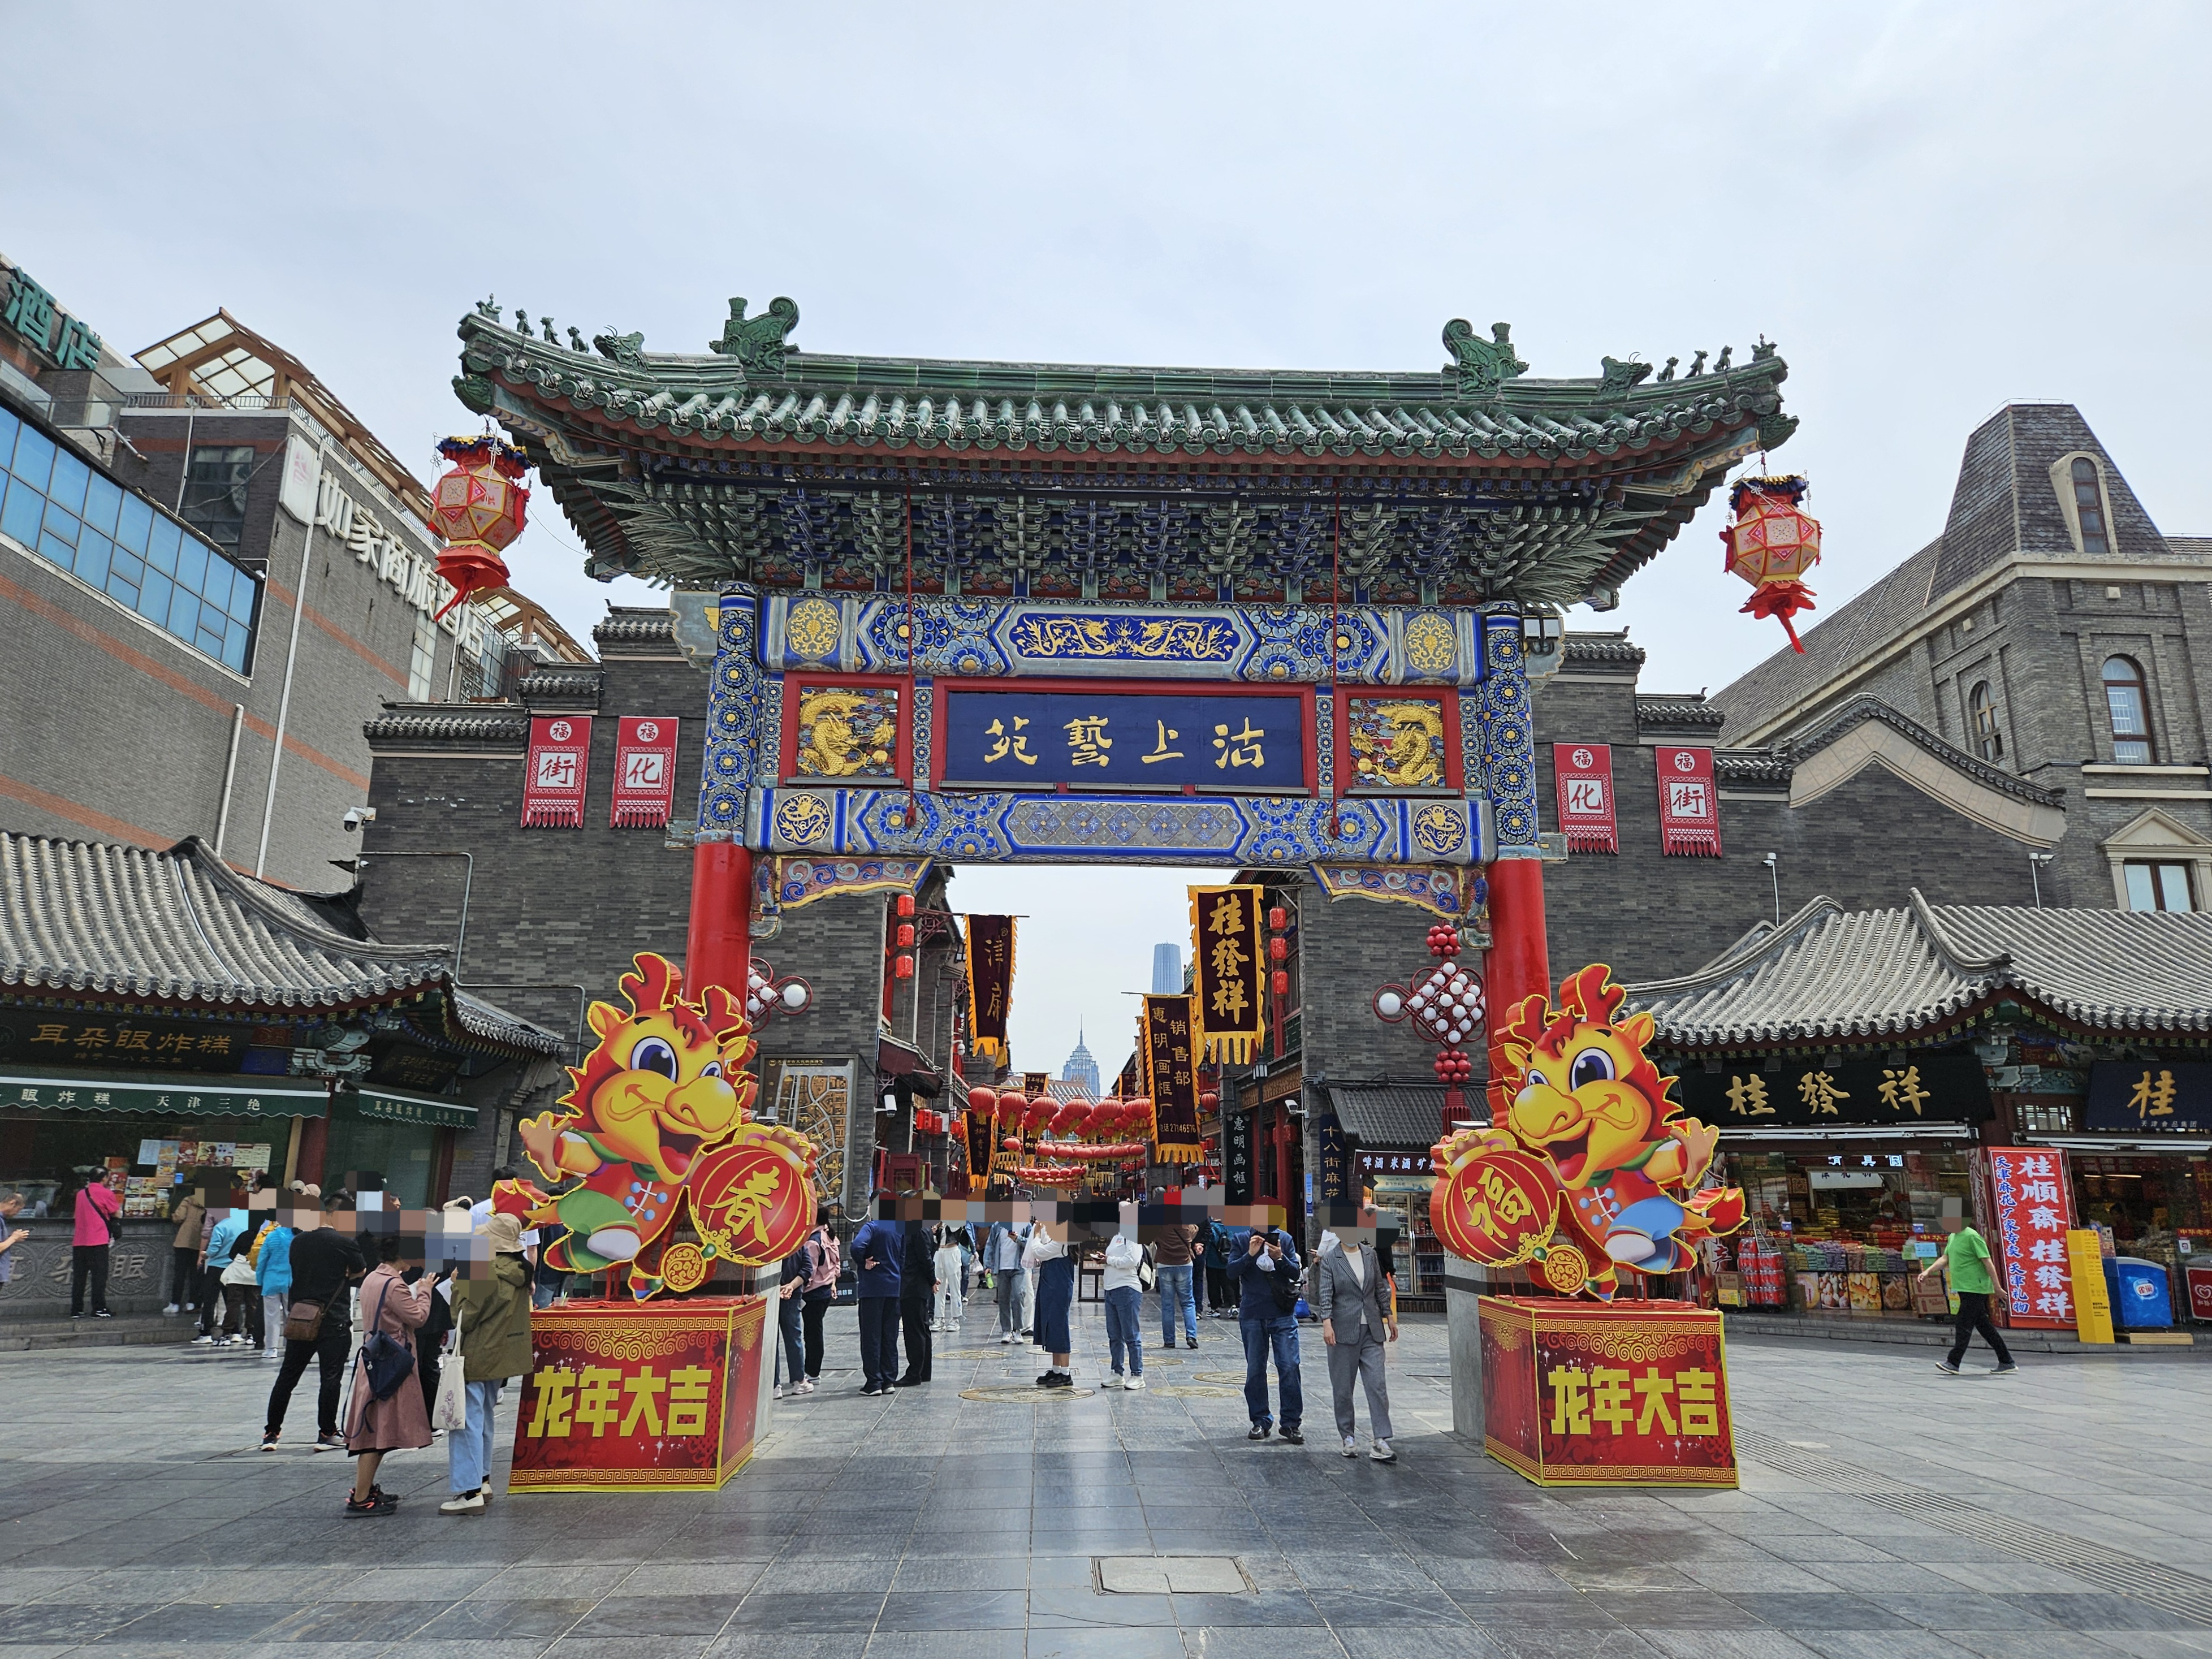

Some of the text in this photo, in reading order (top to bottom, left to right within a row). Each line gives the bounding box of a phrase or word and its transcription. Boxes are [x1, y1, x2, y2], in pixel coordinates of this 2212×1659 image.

[5, 266, 102, 370] 酒店
[314, 469, 485, 658] 如家商旅酒店
[553, 723, 569, 740] 福
[640, 723, 656, 740] 福
[539, 758, 575, 785] 街
[627, 757, 661, 785] 化
[1575, 750, 1592, 768] 福
[1677, 753, 1694, 770] 福
[1570, 783, 1602, 811] 化
[1672, 788, 1704, 814] 街
[1208, 893, 1249, 1025] 桂發祥
[30, 1024, 232, 1055] 耳朵眼炸糕
[1151, 1006, 1173, 1118] 惠明画框厂
[1169, 1019, 1191, 1086] 销售部
[0, 1087, 261, 1111] 眼炸糕 天津三绝
[1725, 1065, 1931, 1116] 桂發祥
[2127, 1070, 2178, 1119] 桂
[1323, 1125, 1342, 1198] 十八街麻花
[1362, 1155, 1384, 1170] 啤酒
[1390, 1156, 1411, 1170] 米酒
[704, 1165, 780, 1248] 春
[1464, 1167, 1532, 1239] 福
[1994, 1155, 2030, 1314] 天津麻花厂家专卖 天津礼物
[2029, 1238, 2074, 1319] 桂發祥
[528, 1366, 712, 1437] 龙年大吉
[1548, 1365, 1720, 1436] 龙年大吉
